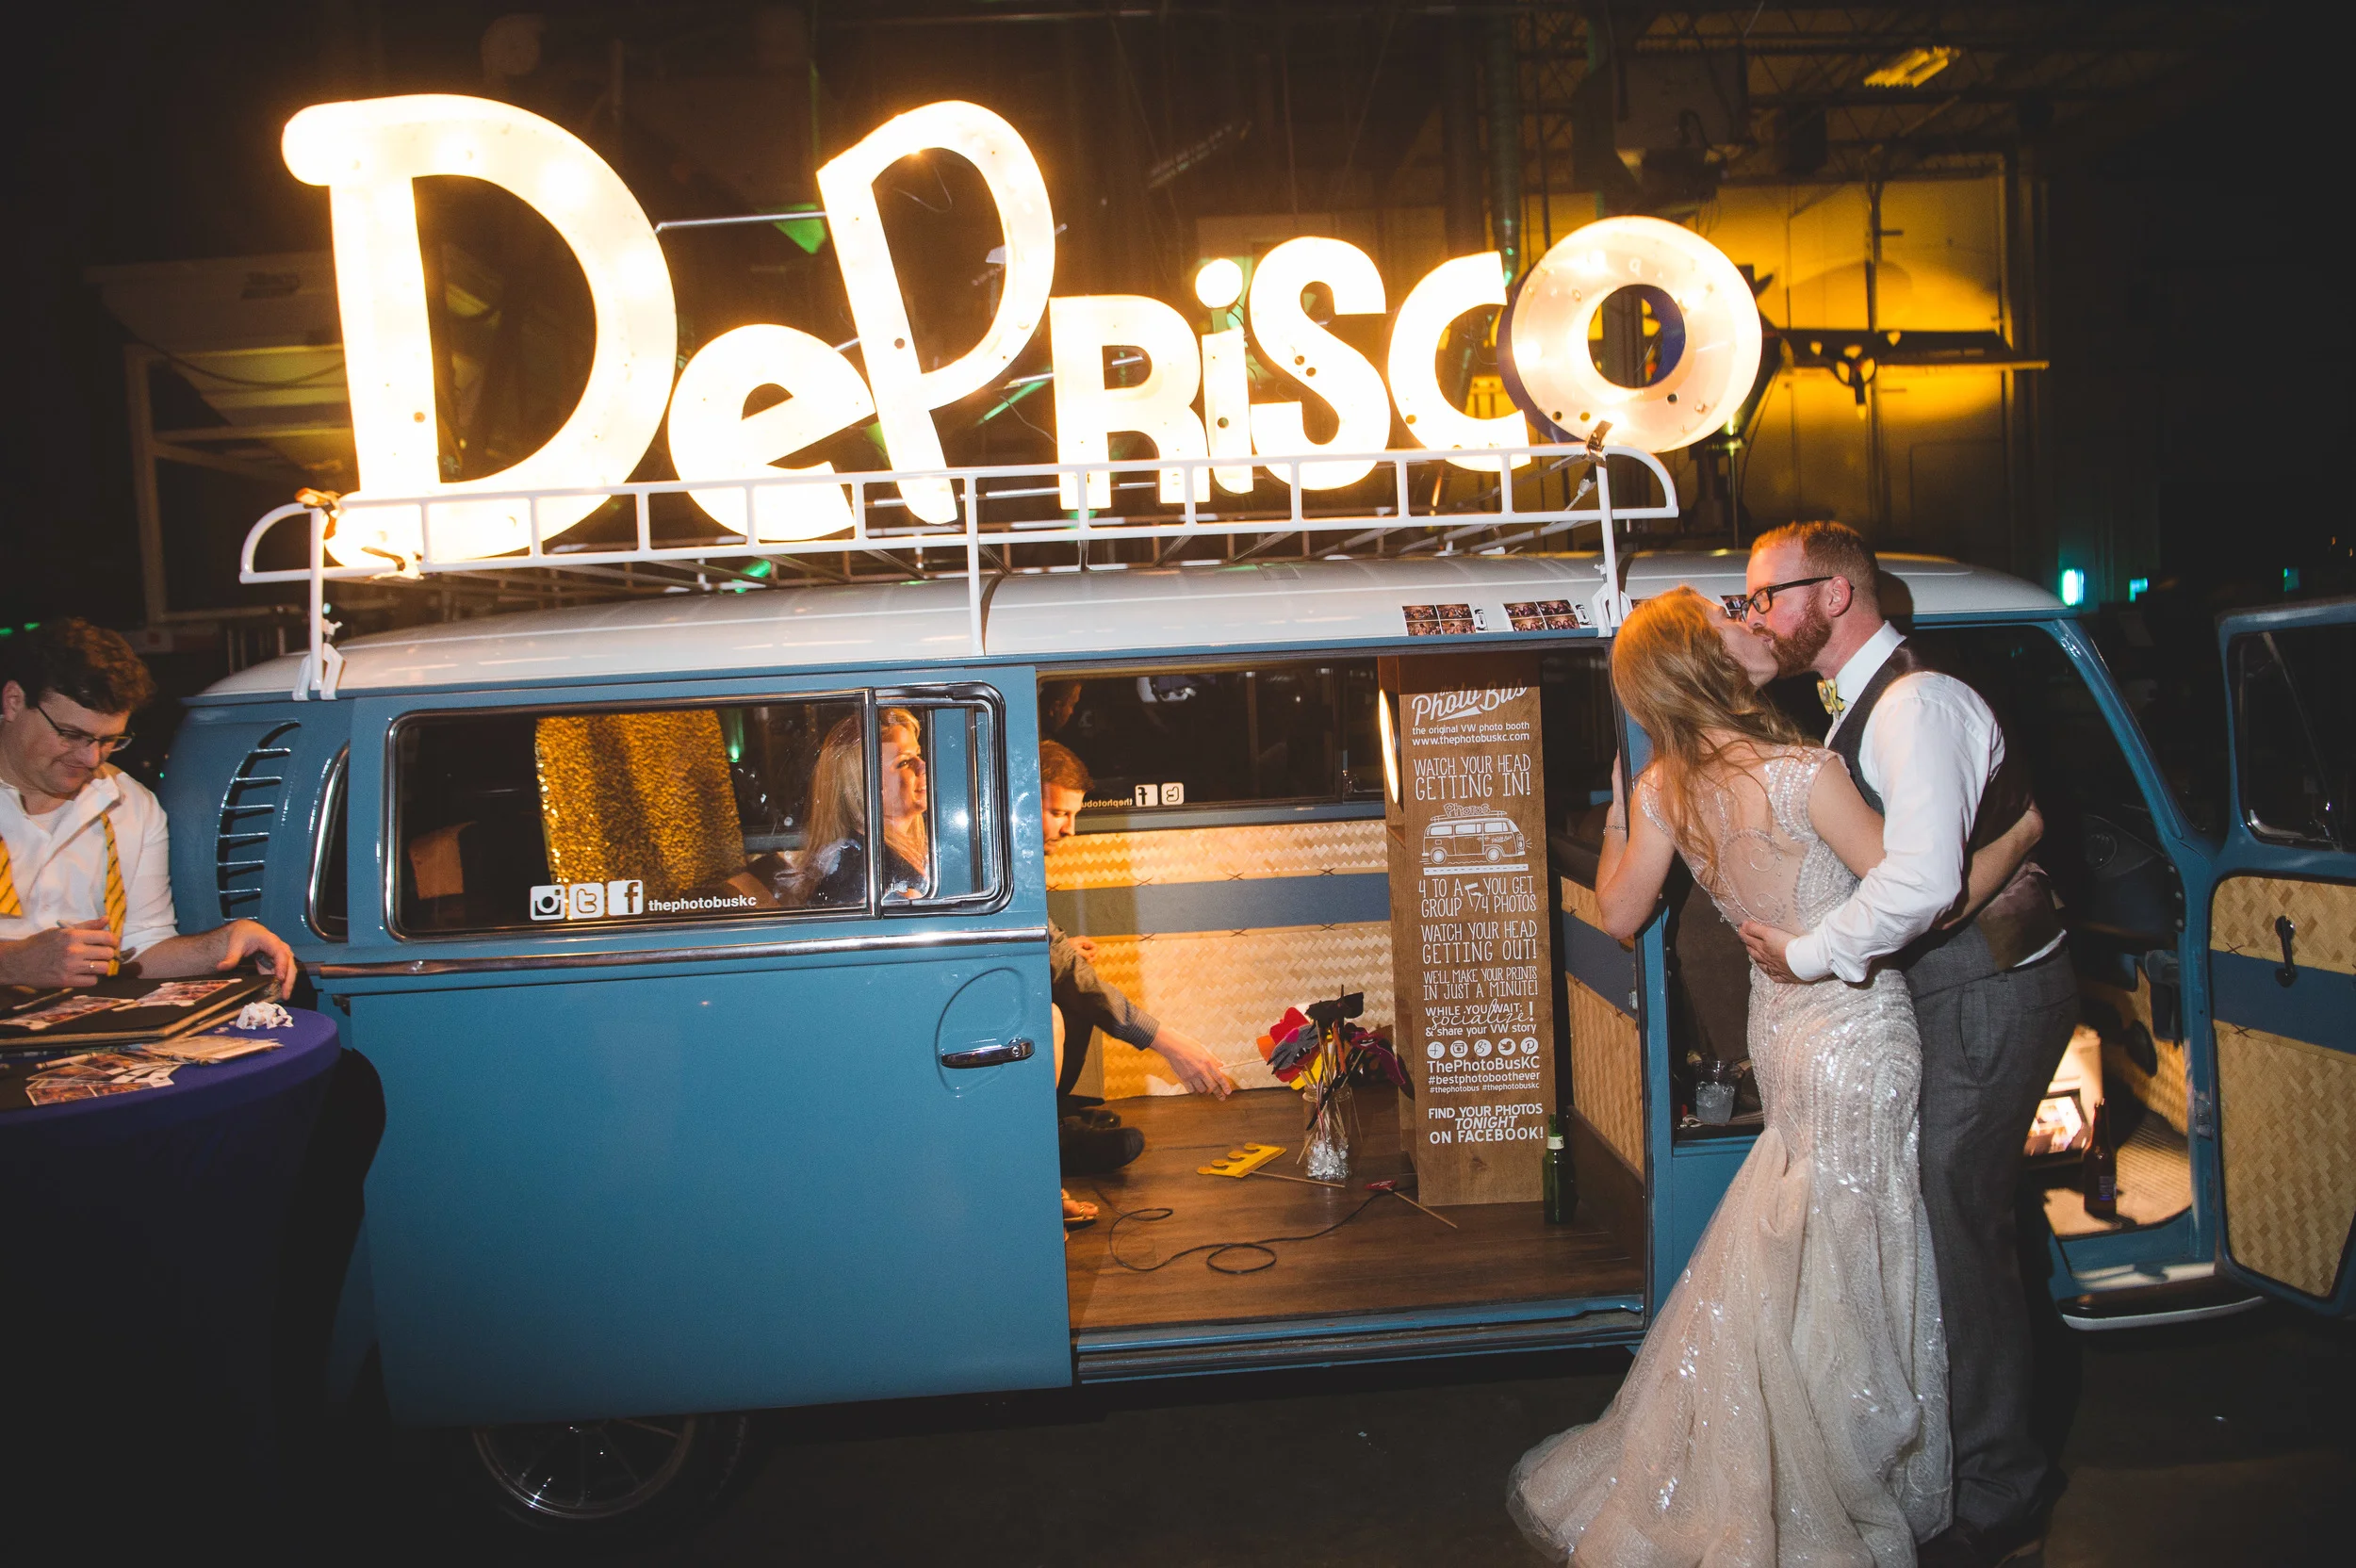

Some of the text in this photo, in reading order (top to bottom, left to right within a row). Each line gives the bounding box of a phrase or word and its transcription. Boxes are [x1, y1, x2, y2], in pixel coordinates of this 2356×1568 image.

[1412, 731, 1530, 746] www.thephotobuskc.com
[1413, 721, 1530, 737] the original VW photo booth
[1414, 754, 1531, 776] WATCH YOUR HEAD
[1415, 772, 1531, 801] GETTING IN!
[1418, 878, 1463, 898] 4 TO A
[1483, 876, 1534, 895] YOU GET
[648, 894, 758, 912] thephotobuskc
[1421, 897, 1463, 918] GROUP
[1481, 894, 1536, 914] 4 PHOTOS
[1421, 920, 1538, 942] WATCH YOUR HEAD
[1422, 939, 1538, 965] GETTING OUT!
[1452, 969, 1478, 984] MAKE
[1481, 967, 1504, 982] YOUR
[1506, 965, 1538, 981] PRINTS
[1423, 980, 1538, 1001] IN JUST A MINUTE!
[1425, 1005, 1461, 1017] WHILE
[1465, 1004, 1488, 1016] YOU
[1425, 1023, 1536, 1037] & share your VW story
[1427, 1055, 1540, 1074] ThePhotoBusKC
[1428, 1071, 1540, 1086] #bestphotoboothever
[1430, 1083, 1540, 1094] #thephotobus #thephotobuskc
[1429, 1103, 1544, 1119] FIND YOUR PHOTOS
[1455, 1116, 1517, 1130] TONIGHT
[1429, 1127, 1544, 1145] ON FACEBOOK!
